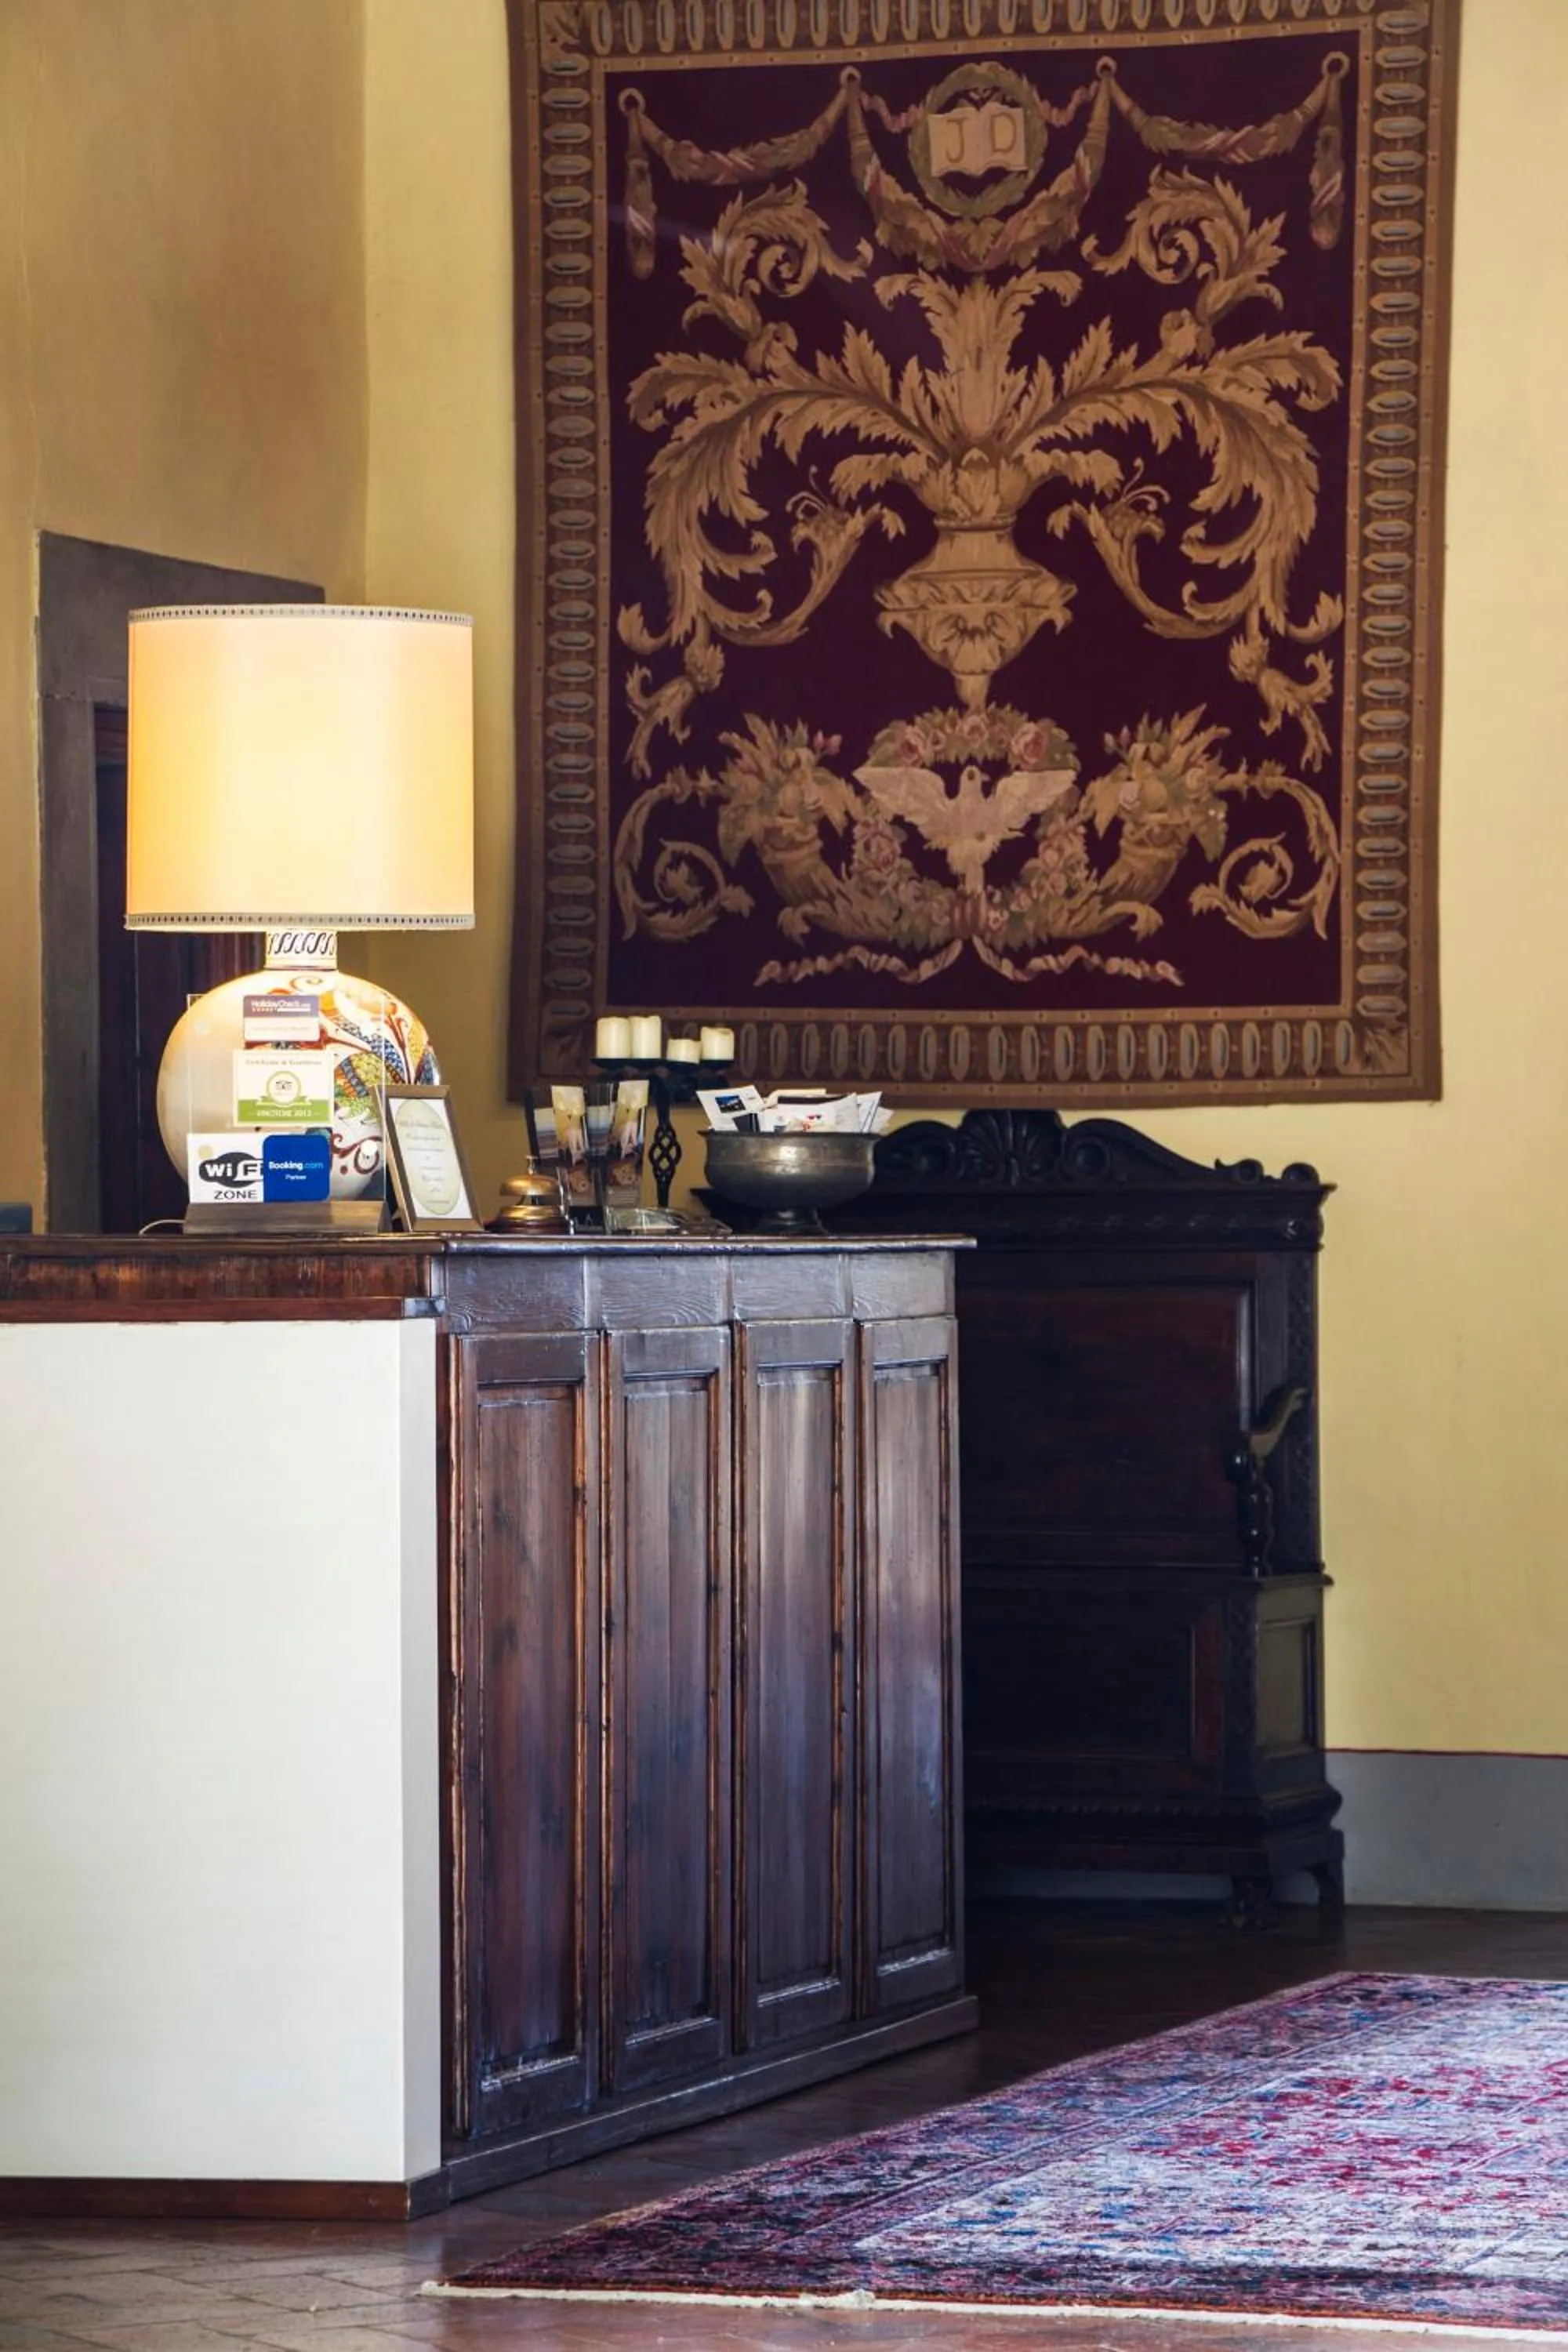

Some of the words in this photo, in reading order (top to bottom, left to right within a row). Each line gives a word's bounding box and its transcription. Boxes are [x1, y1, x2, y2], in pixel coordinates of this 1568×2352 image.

[946, 117, 968, 163] J
[990, 112, 1017, 153] D
[269, 1161, 323, 1171] Booking.com
[213, 1189, 257, 1200] ZONE
